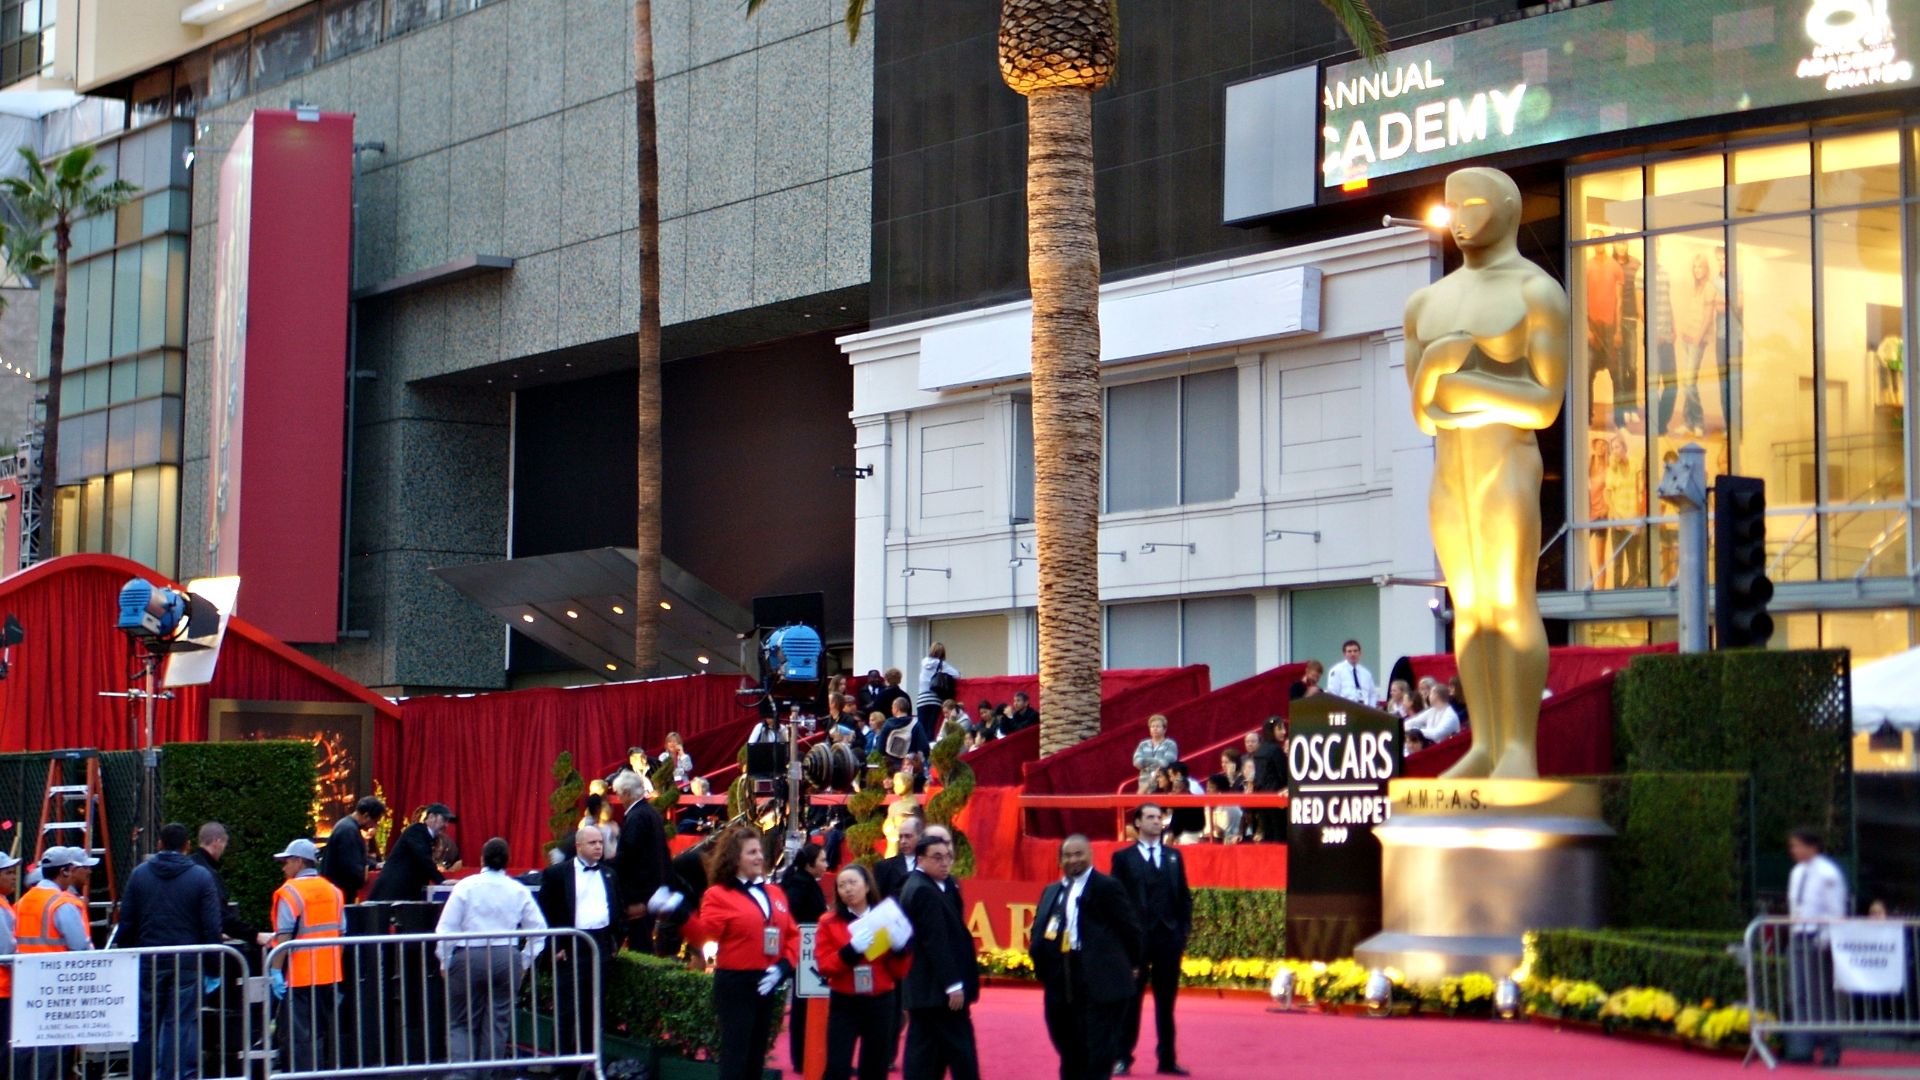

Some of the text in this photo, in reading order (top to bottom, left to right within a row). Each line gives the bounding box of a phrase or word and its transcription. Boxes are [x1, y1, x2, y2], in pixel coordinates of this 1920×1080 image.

[1328, 712, 1347, 726] THE
[1289, 731, 1393, 781] OSCARS
[1291, 797, 1324, 825] RED
[1321, 827, 1348, 844] 2009
[40, 959, 114, 970] THIS PROPERTY
[57, 972, 97, 982] CLOSED
[40, 984, 112, 995] TO THE PUBLIC
[26, 996, 125, 1009] NO ENTRY WITHOUT
[45, 1010, 107, 1021] PERMISSION
